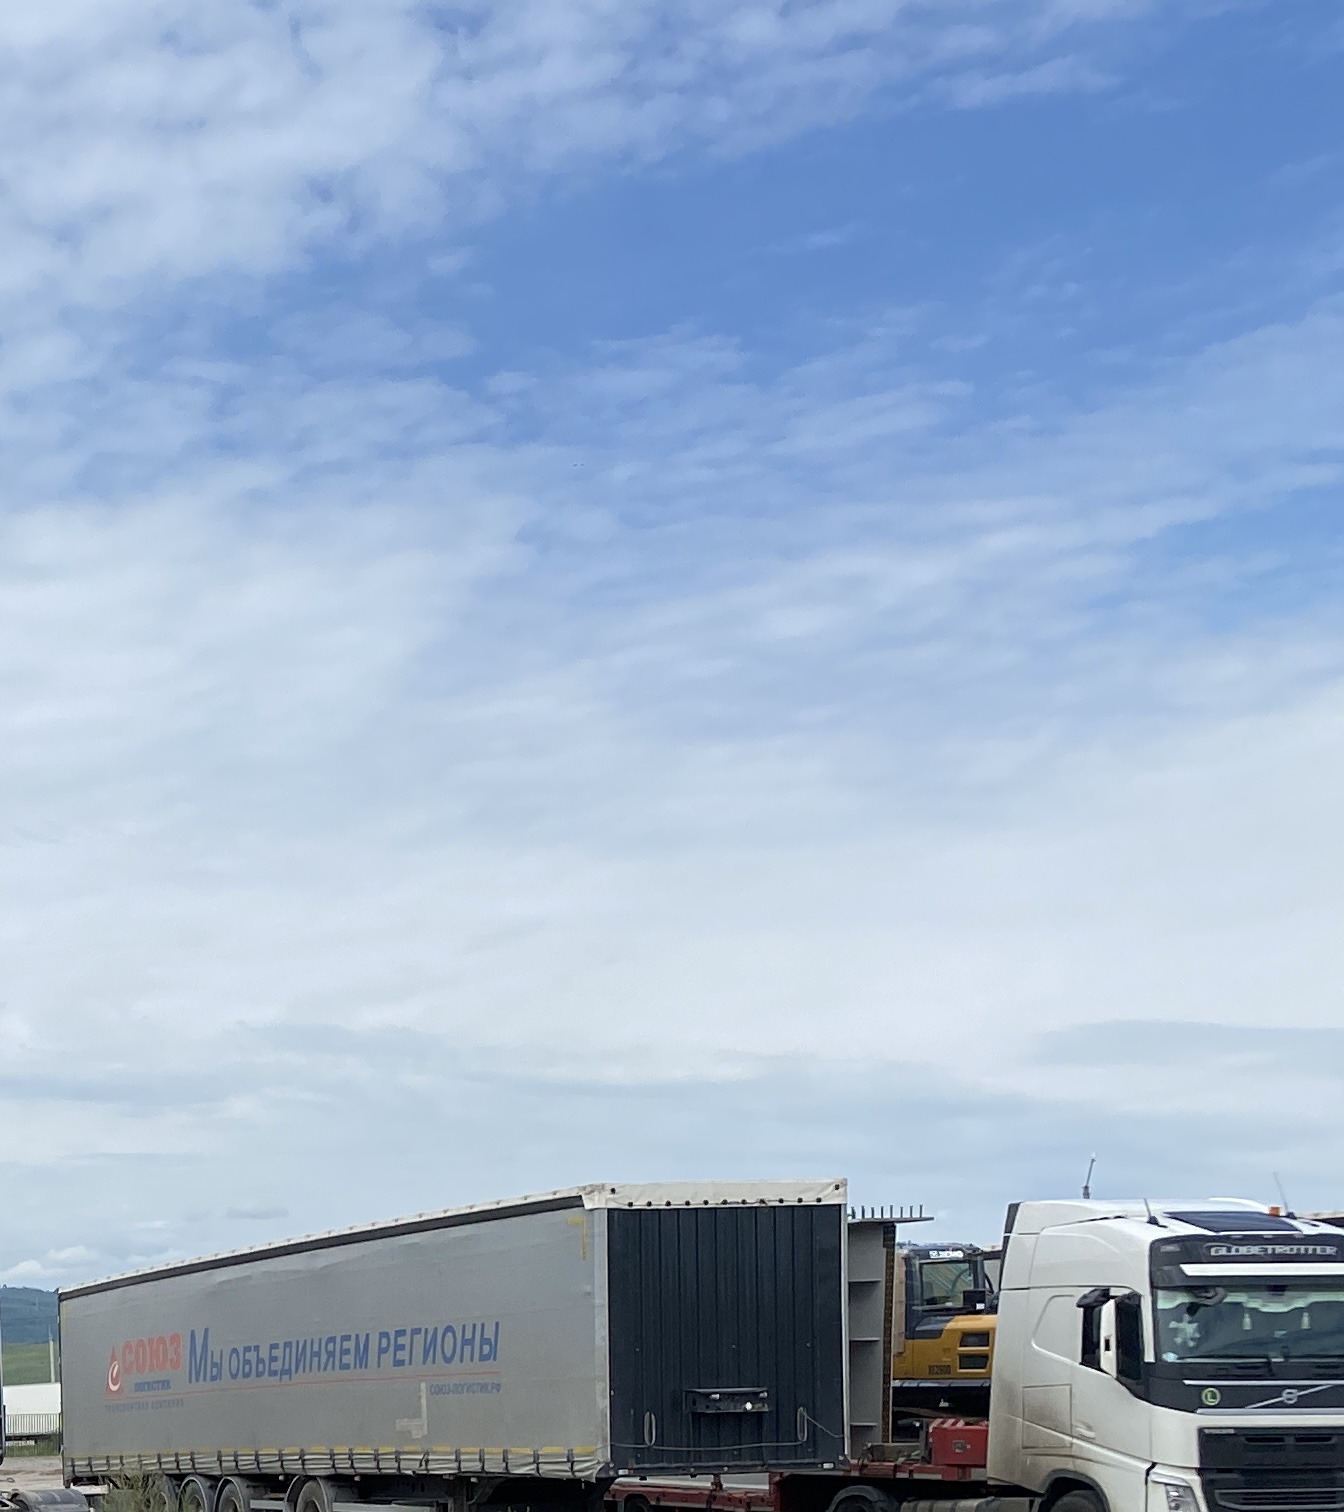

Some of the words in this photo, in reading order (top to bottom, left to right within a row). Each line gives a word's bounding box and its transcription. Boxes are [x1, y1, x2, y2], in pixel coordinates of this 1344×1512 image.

[1210, 1245, 1338, 1256] GLOBETROTTER
[121, 1332, 182, 1375] СОЮЗ
[188, 1327, 223, 1383] Мы
[228, 1332, 370, 1382] ОБЪЕДИНЯЕМ
[376, 1321, 500, 1369] РЕГИОНЫ
